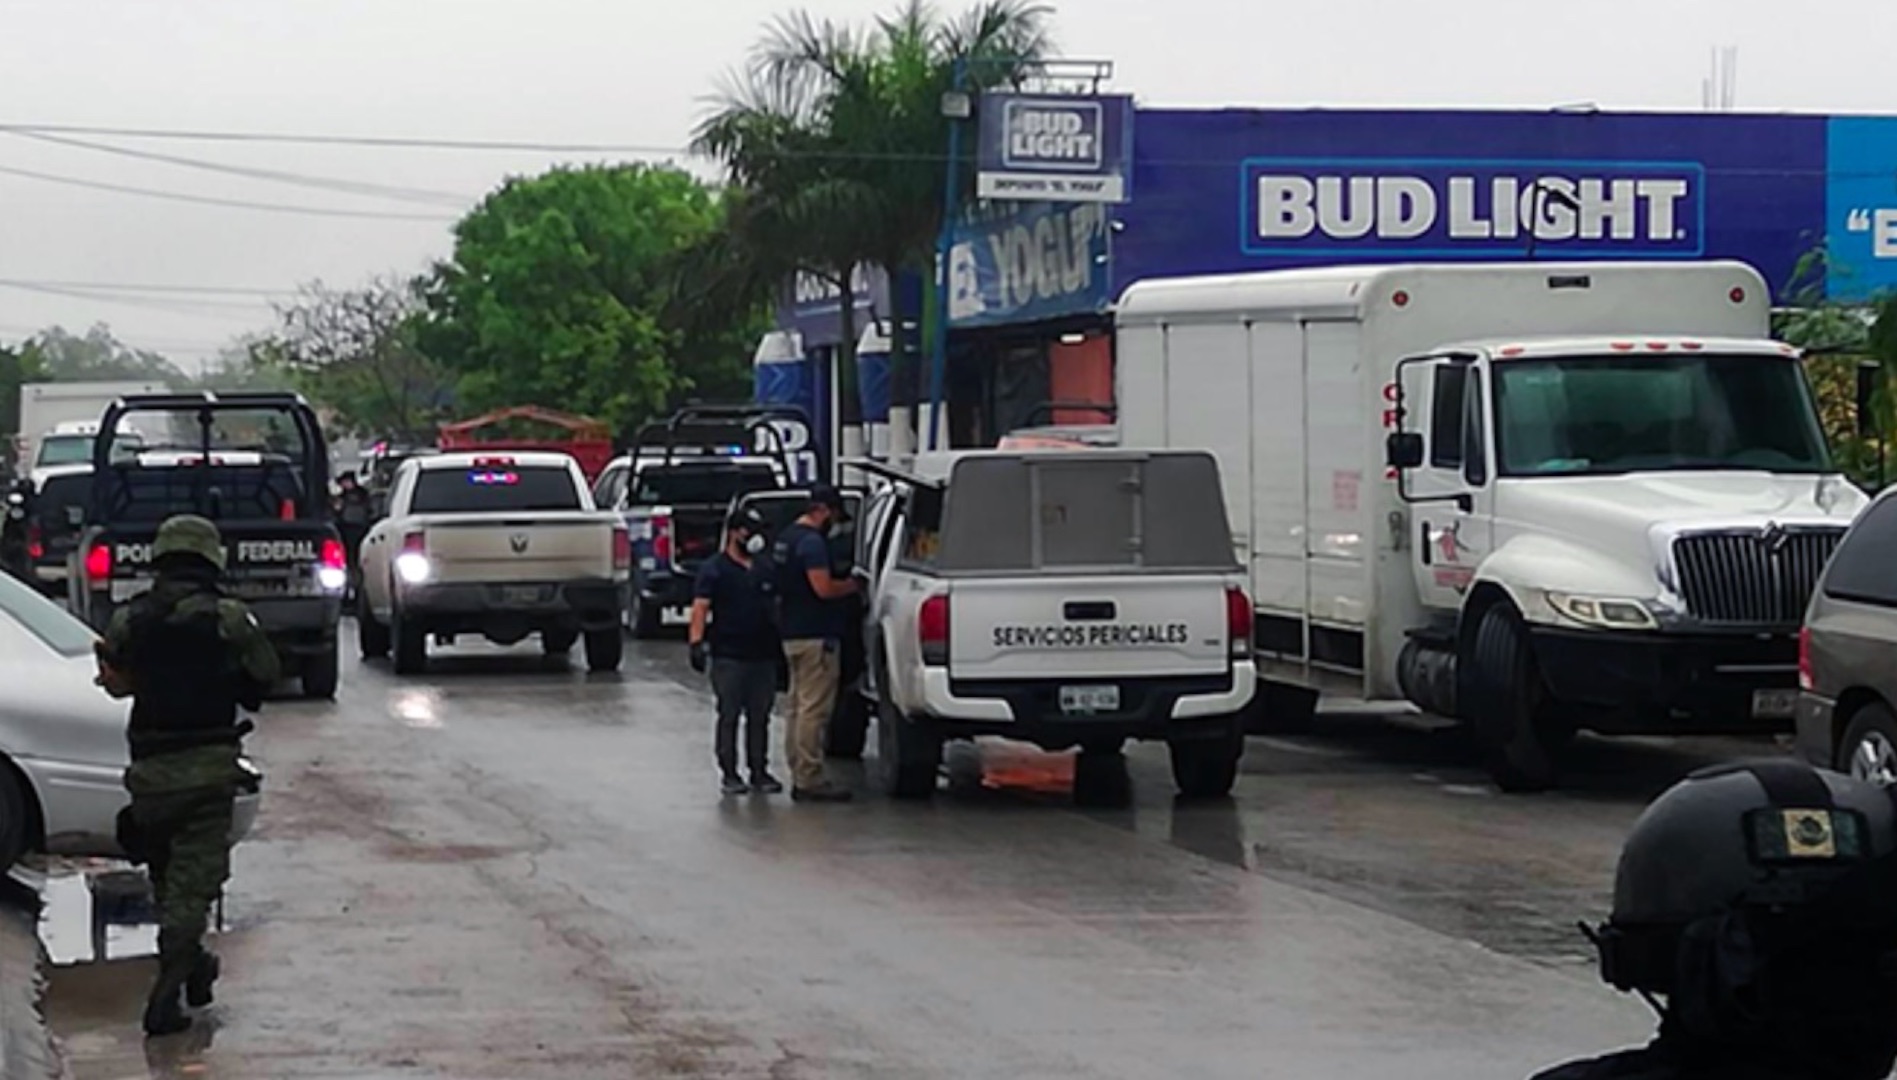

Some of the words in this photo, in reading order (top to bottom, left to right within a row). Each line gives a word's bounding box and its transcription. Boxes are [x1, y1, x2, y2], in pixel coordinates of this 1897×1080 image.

[1023, 111, 1082, 134] BUD
[1011, 133, 1093, 158] LIGHT
[1258, 176, 1437, 238] BUD
[1448, 176, 1688, 240] LIGHT
[237, 540, 318, 560] FEDERAL
[993, 626, 1085, 646] SERVICIOS
[1090, 624, 1188, 644] PERICIALES
